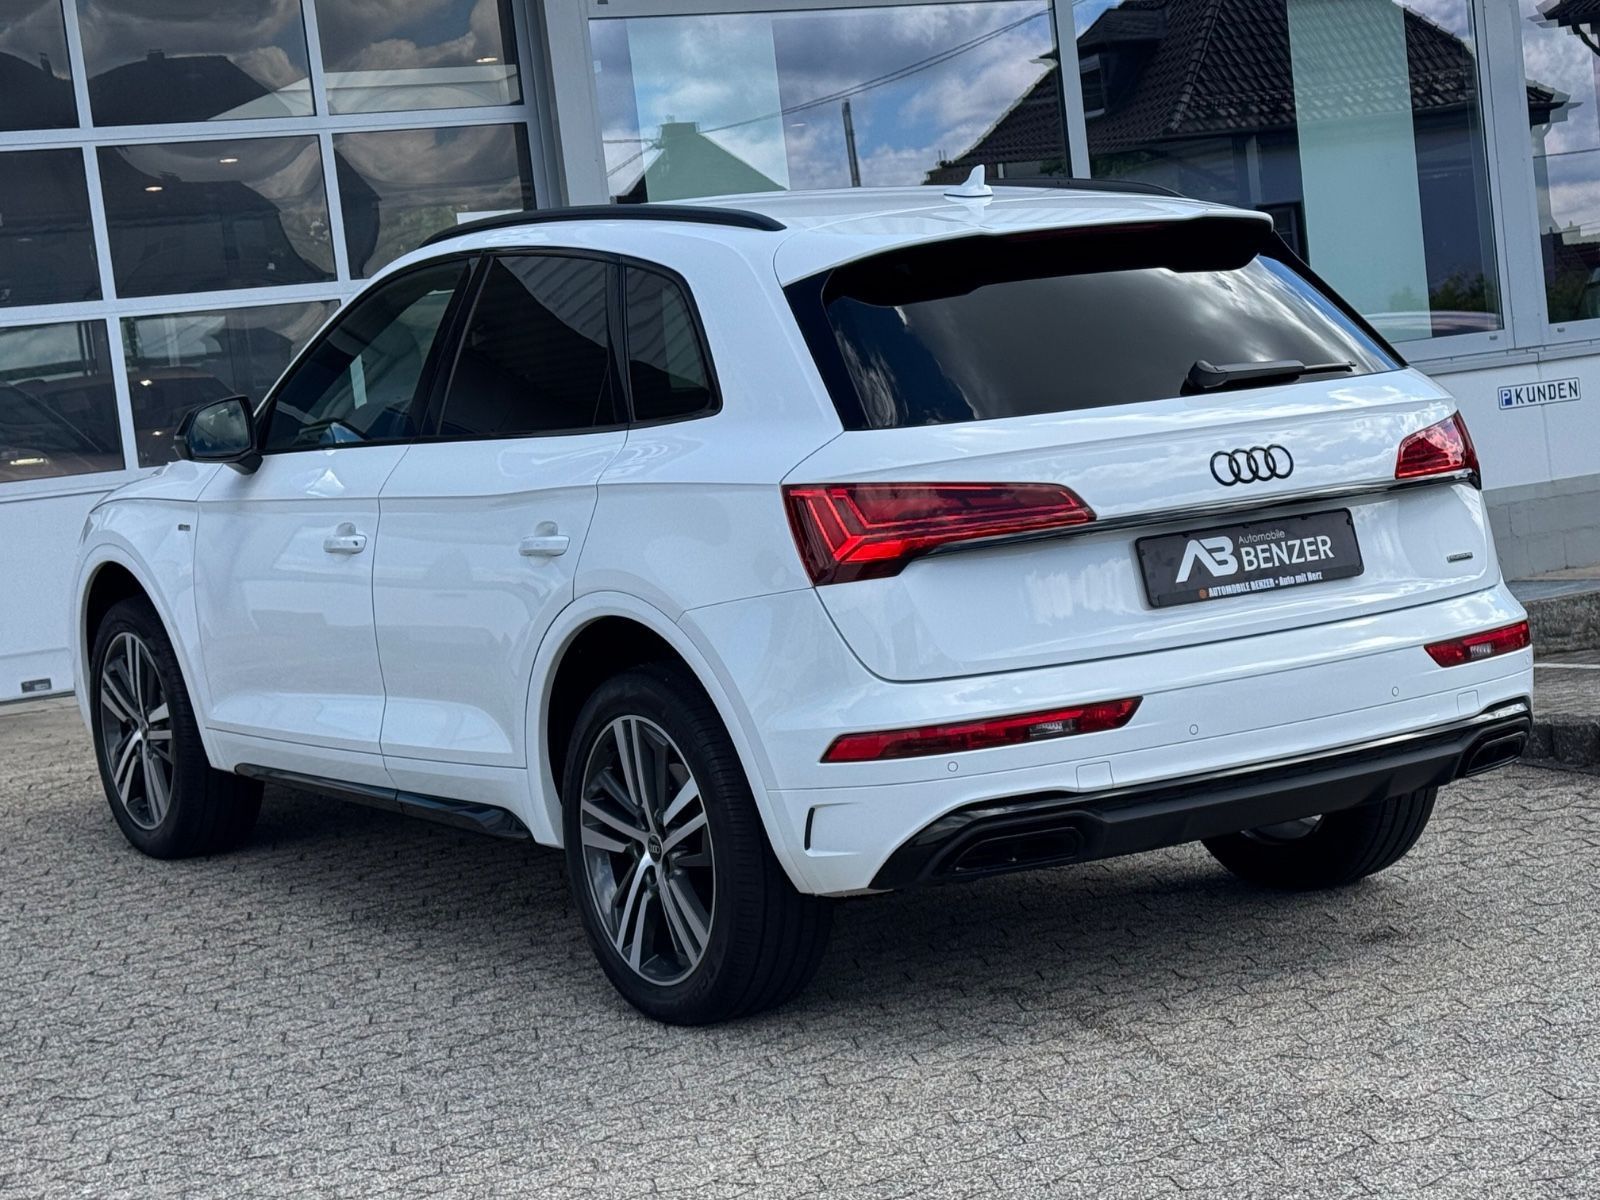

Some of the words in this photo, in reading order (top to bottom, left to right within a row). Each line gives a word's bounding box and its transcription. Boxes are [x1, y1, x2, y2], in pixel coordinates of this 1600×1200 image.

[1515, 381, 1578, 404] KUNDEN
[1238, 529, 1285, 544] Automobile
[1240, 535, 1335, 572] BENZER
[1209, 582, 1250, 598] AUTOMOBILE
[1250, 578, 1275, 590] BENZER
[1279, 575, 1295, 586] Auto
[1295, 573, 1308, 583] mit
[1308, 571, 1323, 581] Herz
